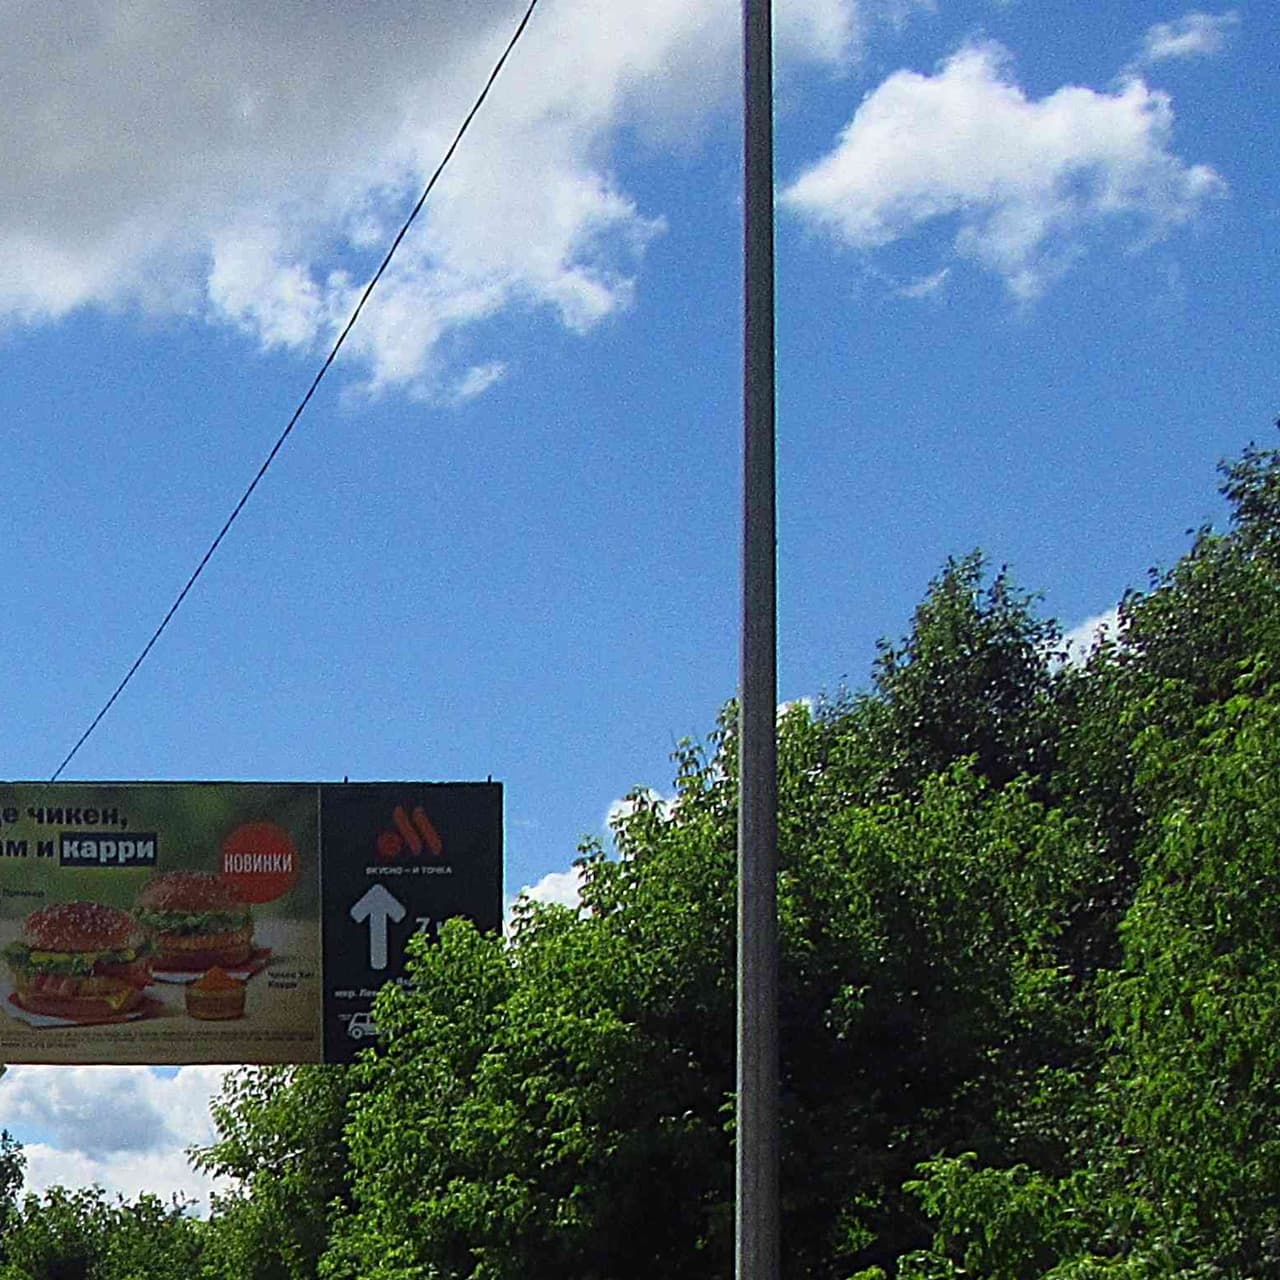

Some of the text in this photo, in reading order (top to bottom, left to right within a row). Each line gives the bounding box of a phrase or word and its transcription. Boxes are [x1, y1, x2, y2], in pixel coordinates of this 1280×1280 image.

[27, 806, 128, 830] чикен,
[37, 839, 54, 857] и
[62, 839, 154, 863] карри
[224, 853, 292, 873] НОВИНКИ
